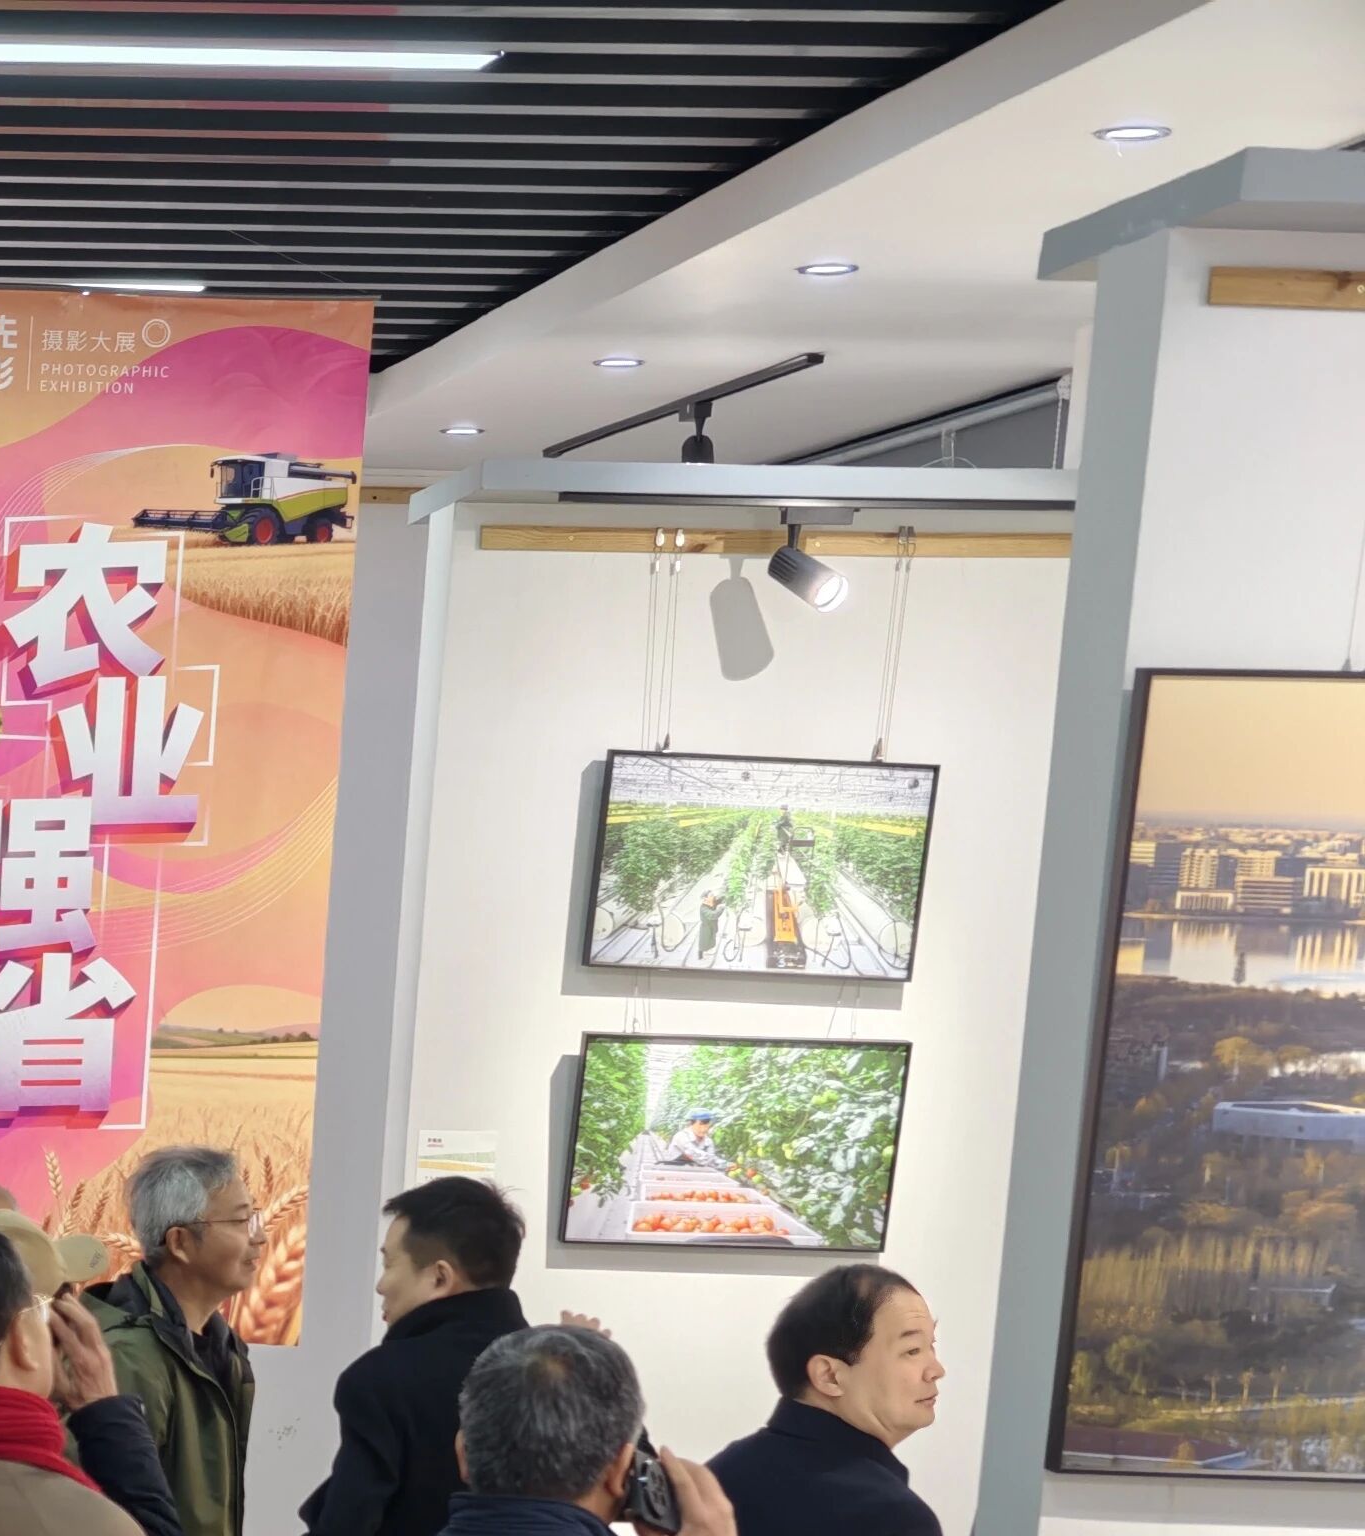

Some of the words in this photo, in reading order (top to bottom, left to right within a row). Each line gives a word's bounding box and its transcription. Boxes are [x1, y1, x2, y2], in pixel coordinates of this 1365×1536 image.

[42, 329, 136, 353] 摄影大展
[40, 362, 170, 379] PHOTOGRAPHIC
[39, 379, 134, 394] EXHIBITION
